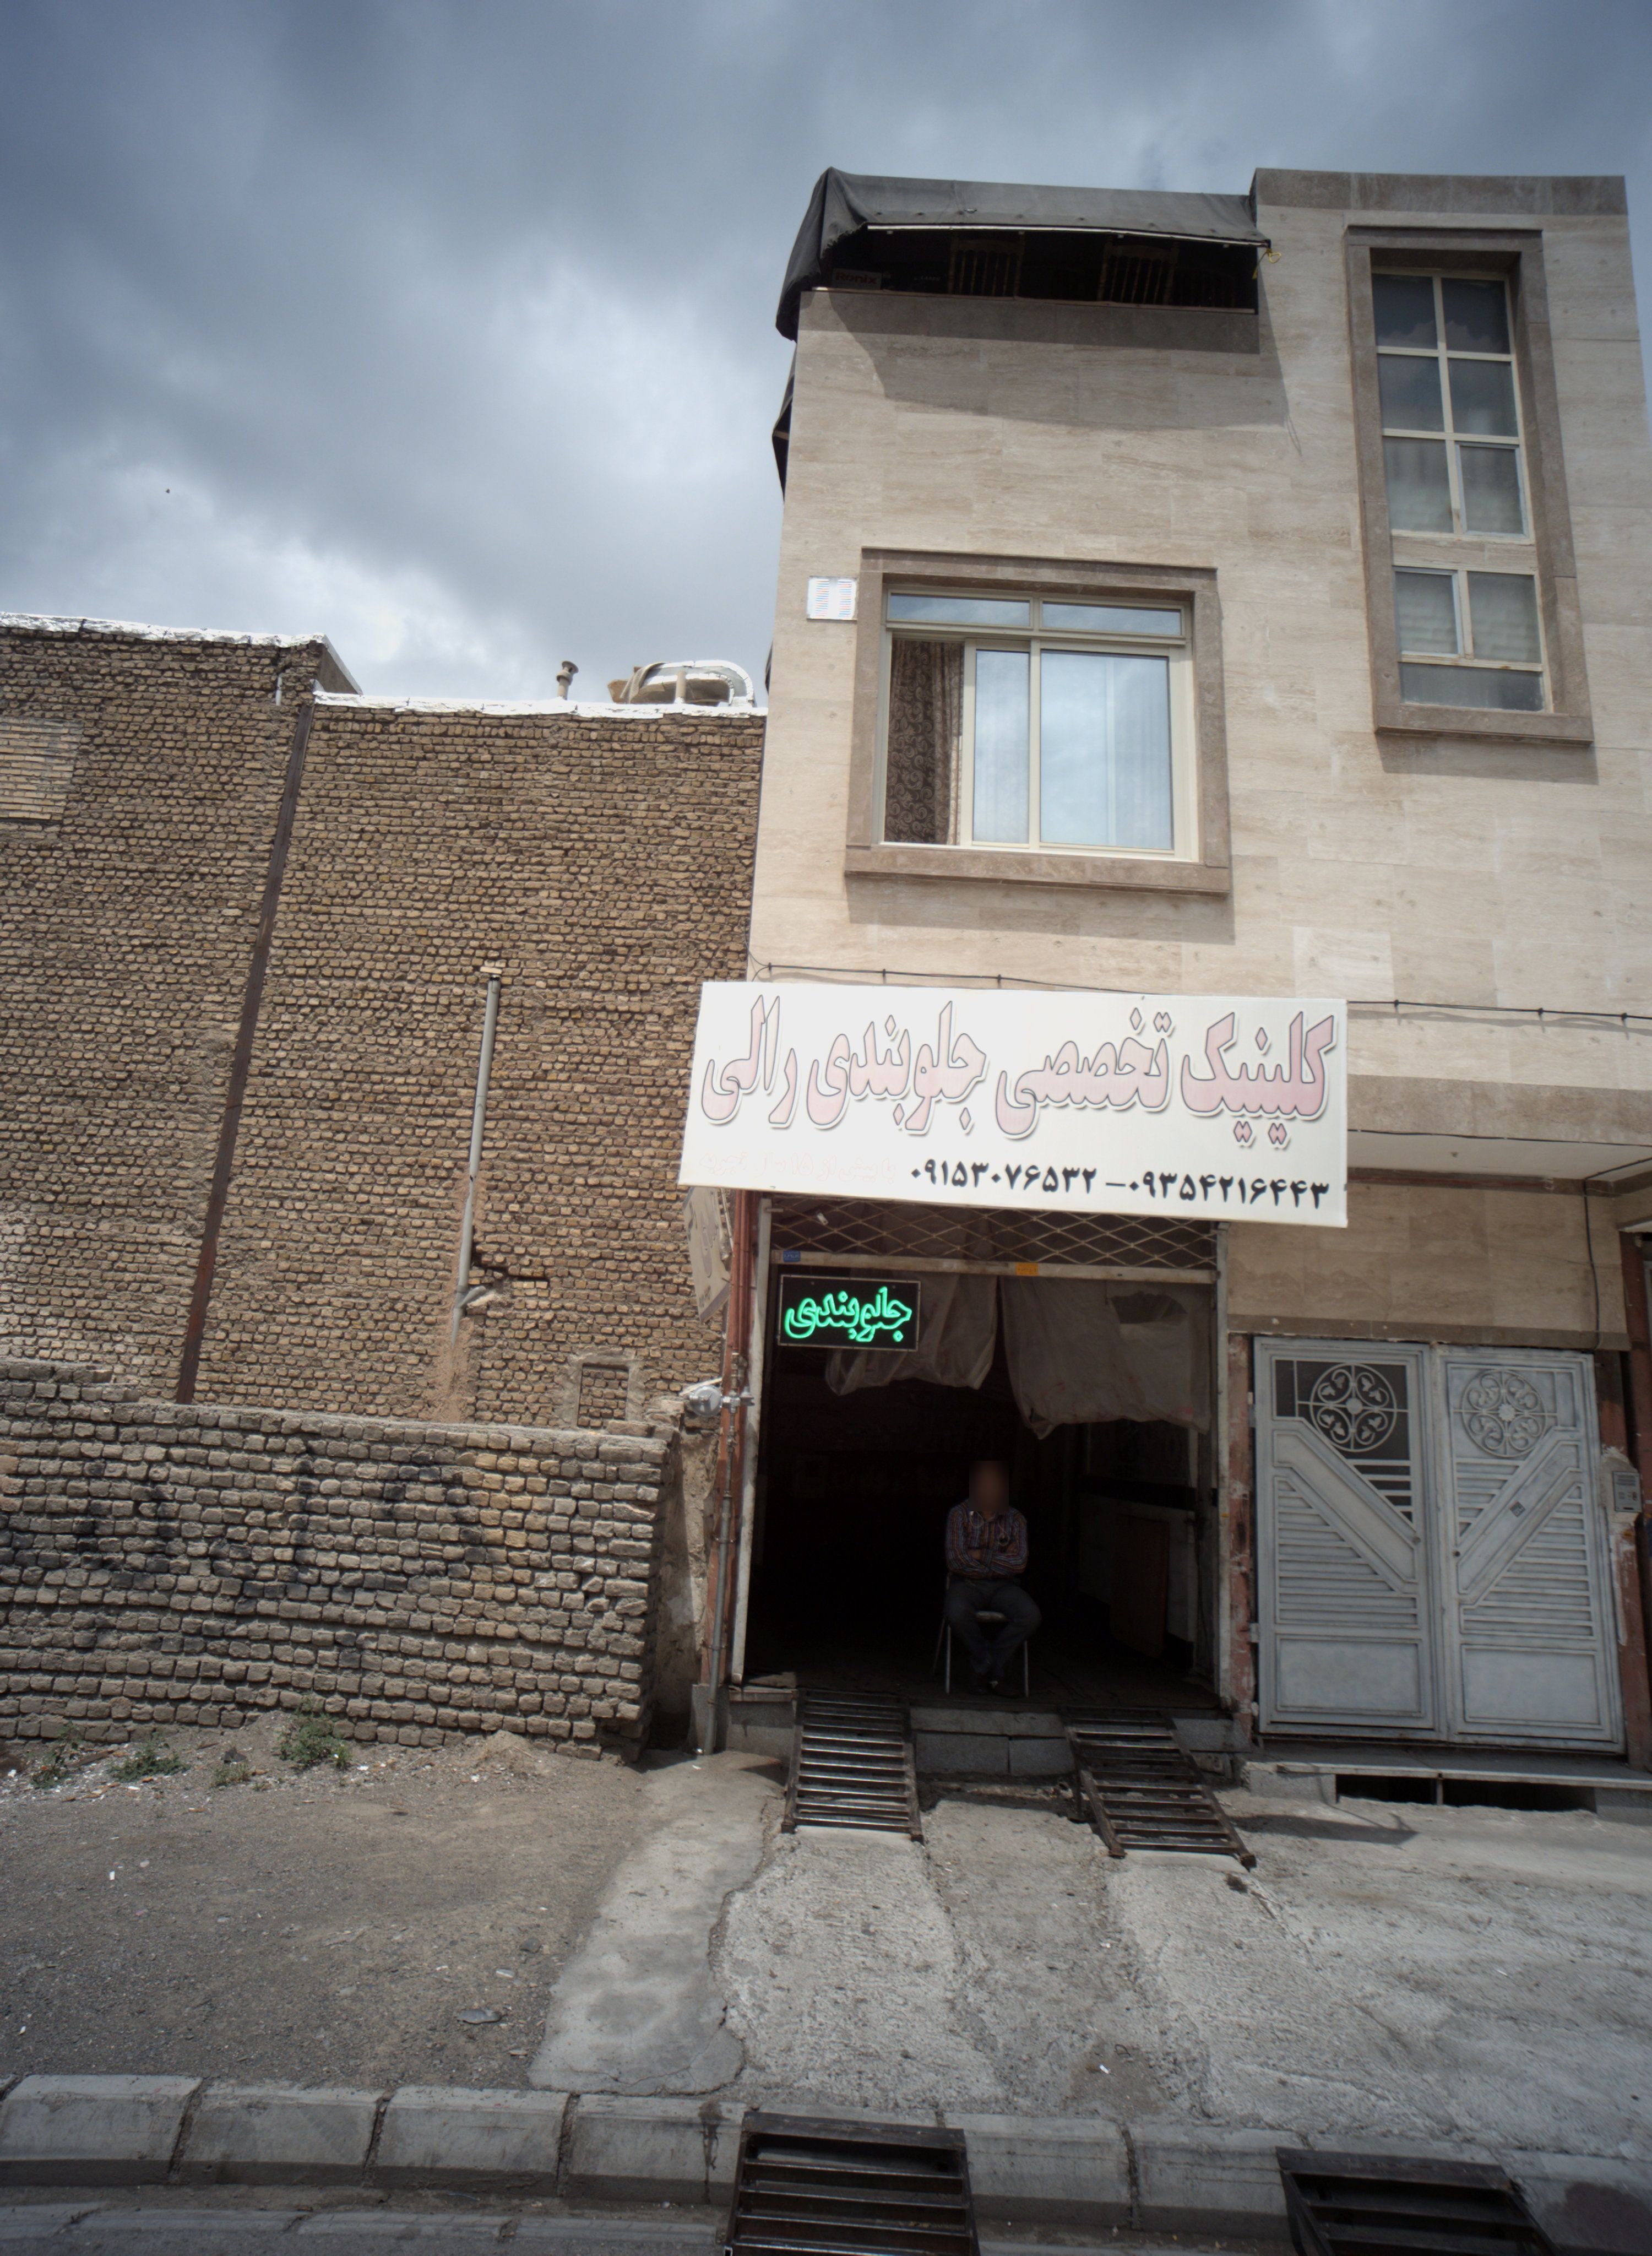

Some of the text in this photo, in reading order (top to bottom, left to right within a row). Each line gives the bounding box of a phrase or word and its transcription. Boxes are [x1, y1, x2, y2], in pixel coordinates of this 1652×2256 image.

[835, 272, 877, 284] Ronix
[702, 994, 1334, 1145] کلینیک تخصصی جلوبندی رالی
[911, 1158, 1097, 1194] ۰۹۱۵۳۰۷۶۵۳۲
[784, 1286, 912, 1342] جلوبندی
